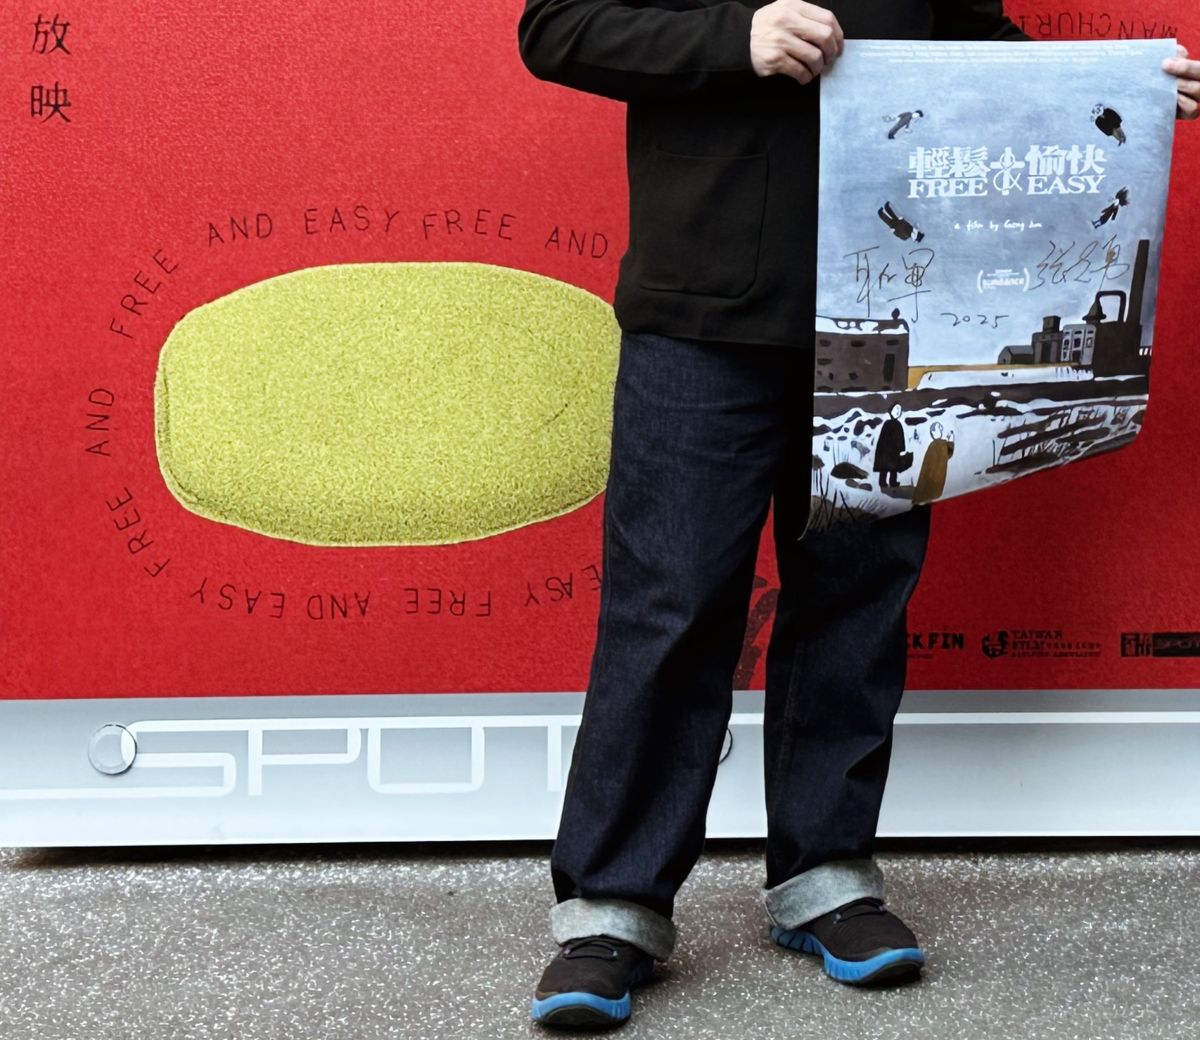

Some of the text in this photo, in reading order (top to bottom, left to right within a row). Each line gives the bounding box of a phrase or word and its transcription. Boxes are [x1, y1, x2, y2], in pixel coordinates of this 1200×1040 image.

[907, 177, 989, 199] FREE
[1026, 174, 1107, 196] EASY
[940, 312, 1009, 329] 2025
[84, 205, 609, 578] FREE AND FREE AND EASY FREE AND
[190, 577, 287, 616] EASY
[306, 591, 371, 621] AND
[404, 587, 493, 618] FREE
